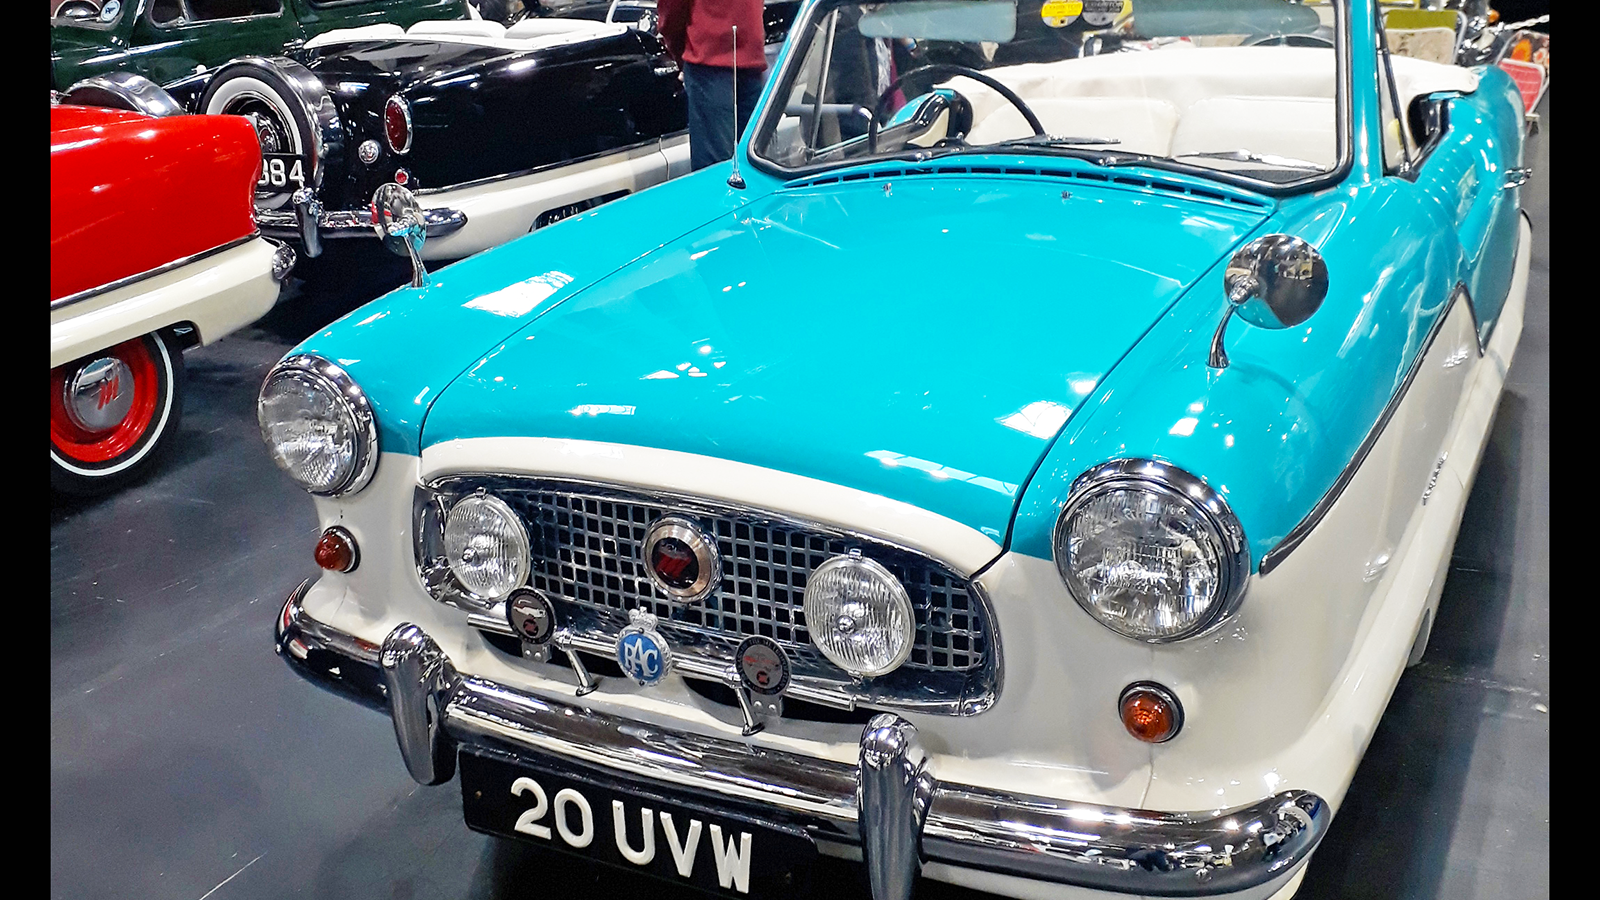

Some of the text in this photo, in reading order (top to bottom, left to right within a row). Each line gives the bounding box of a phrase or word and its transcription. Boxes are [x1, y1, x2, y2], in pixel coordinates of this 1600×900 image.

[624, 637, 659, 677] RAC
[511, 776, 752, 894] 20 UVW
